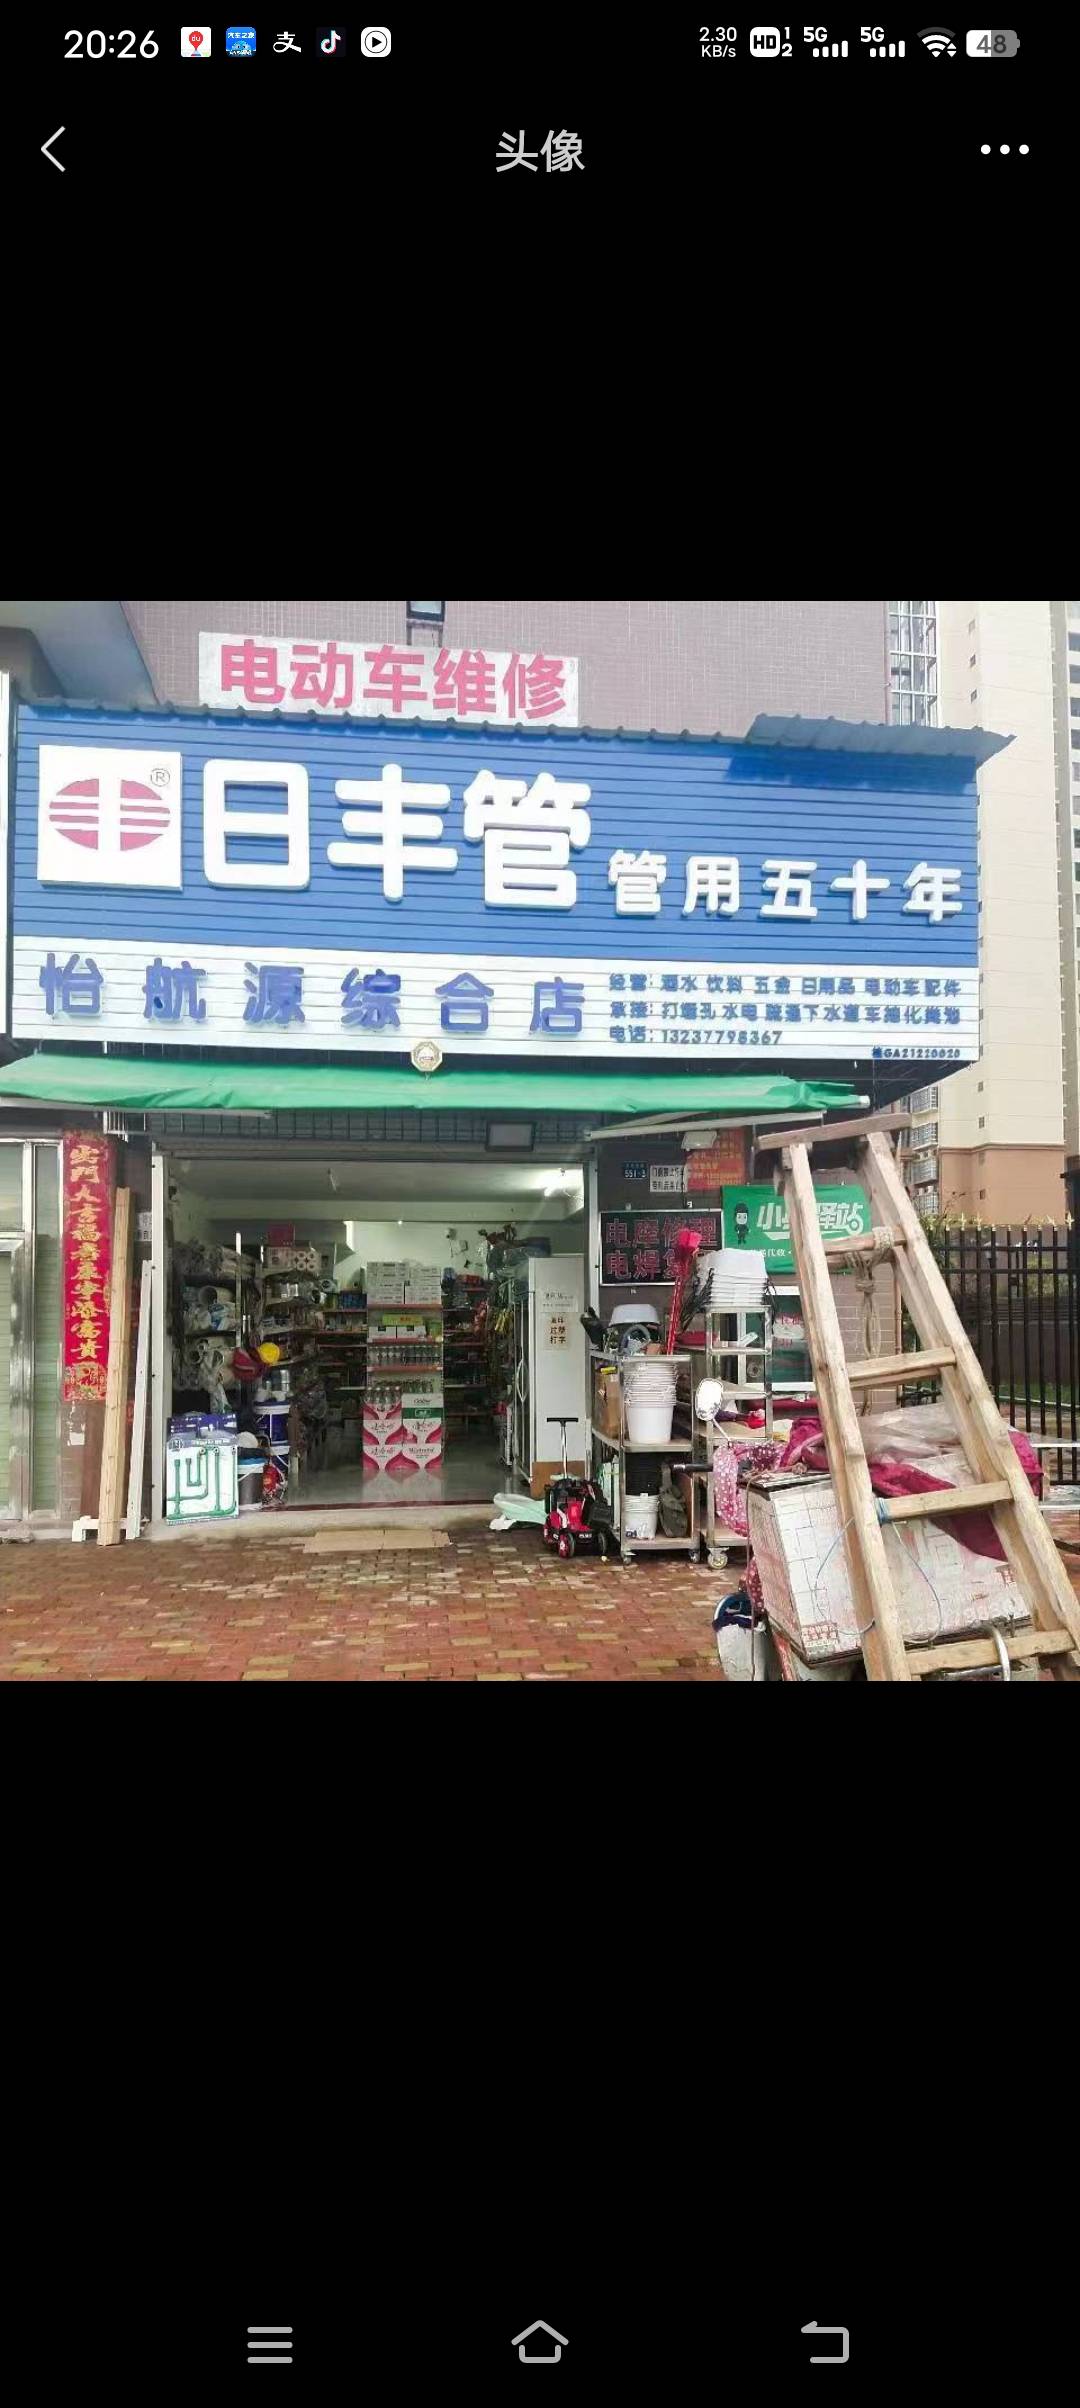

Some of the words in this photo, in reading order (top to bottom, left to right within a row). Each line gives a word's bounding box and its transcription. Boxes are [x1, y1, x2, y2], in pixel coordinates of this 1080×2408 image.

[220, 639, 567, 720] 电动车维修
[203, 759, 592, 909] 日丰管
[607, 849, 963, 924] 管用五十年
[39, 953, 586, 1034] 怡航源综合店
